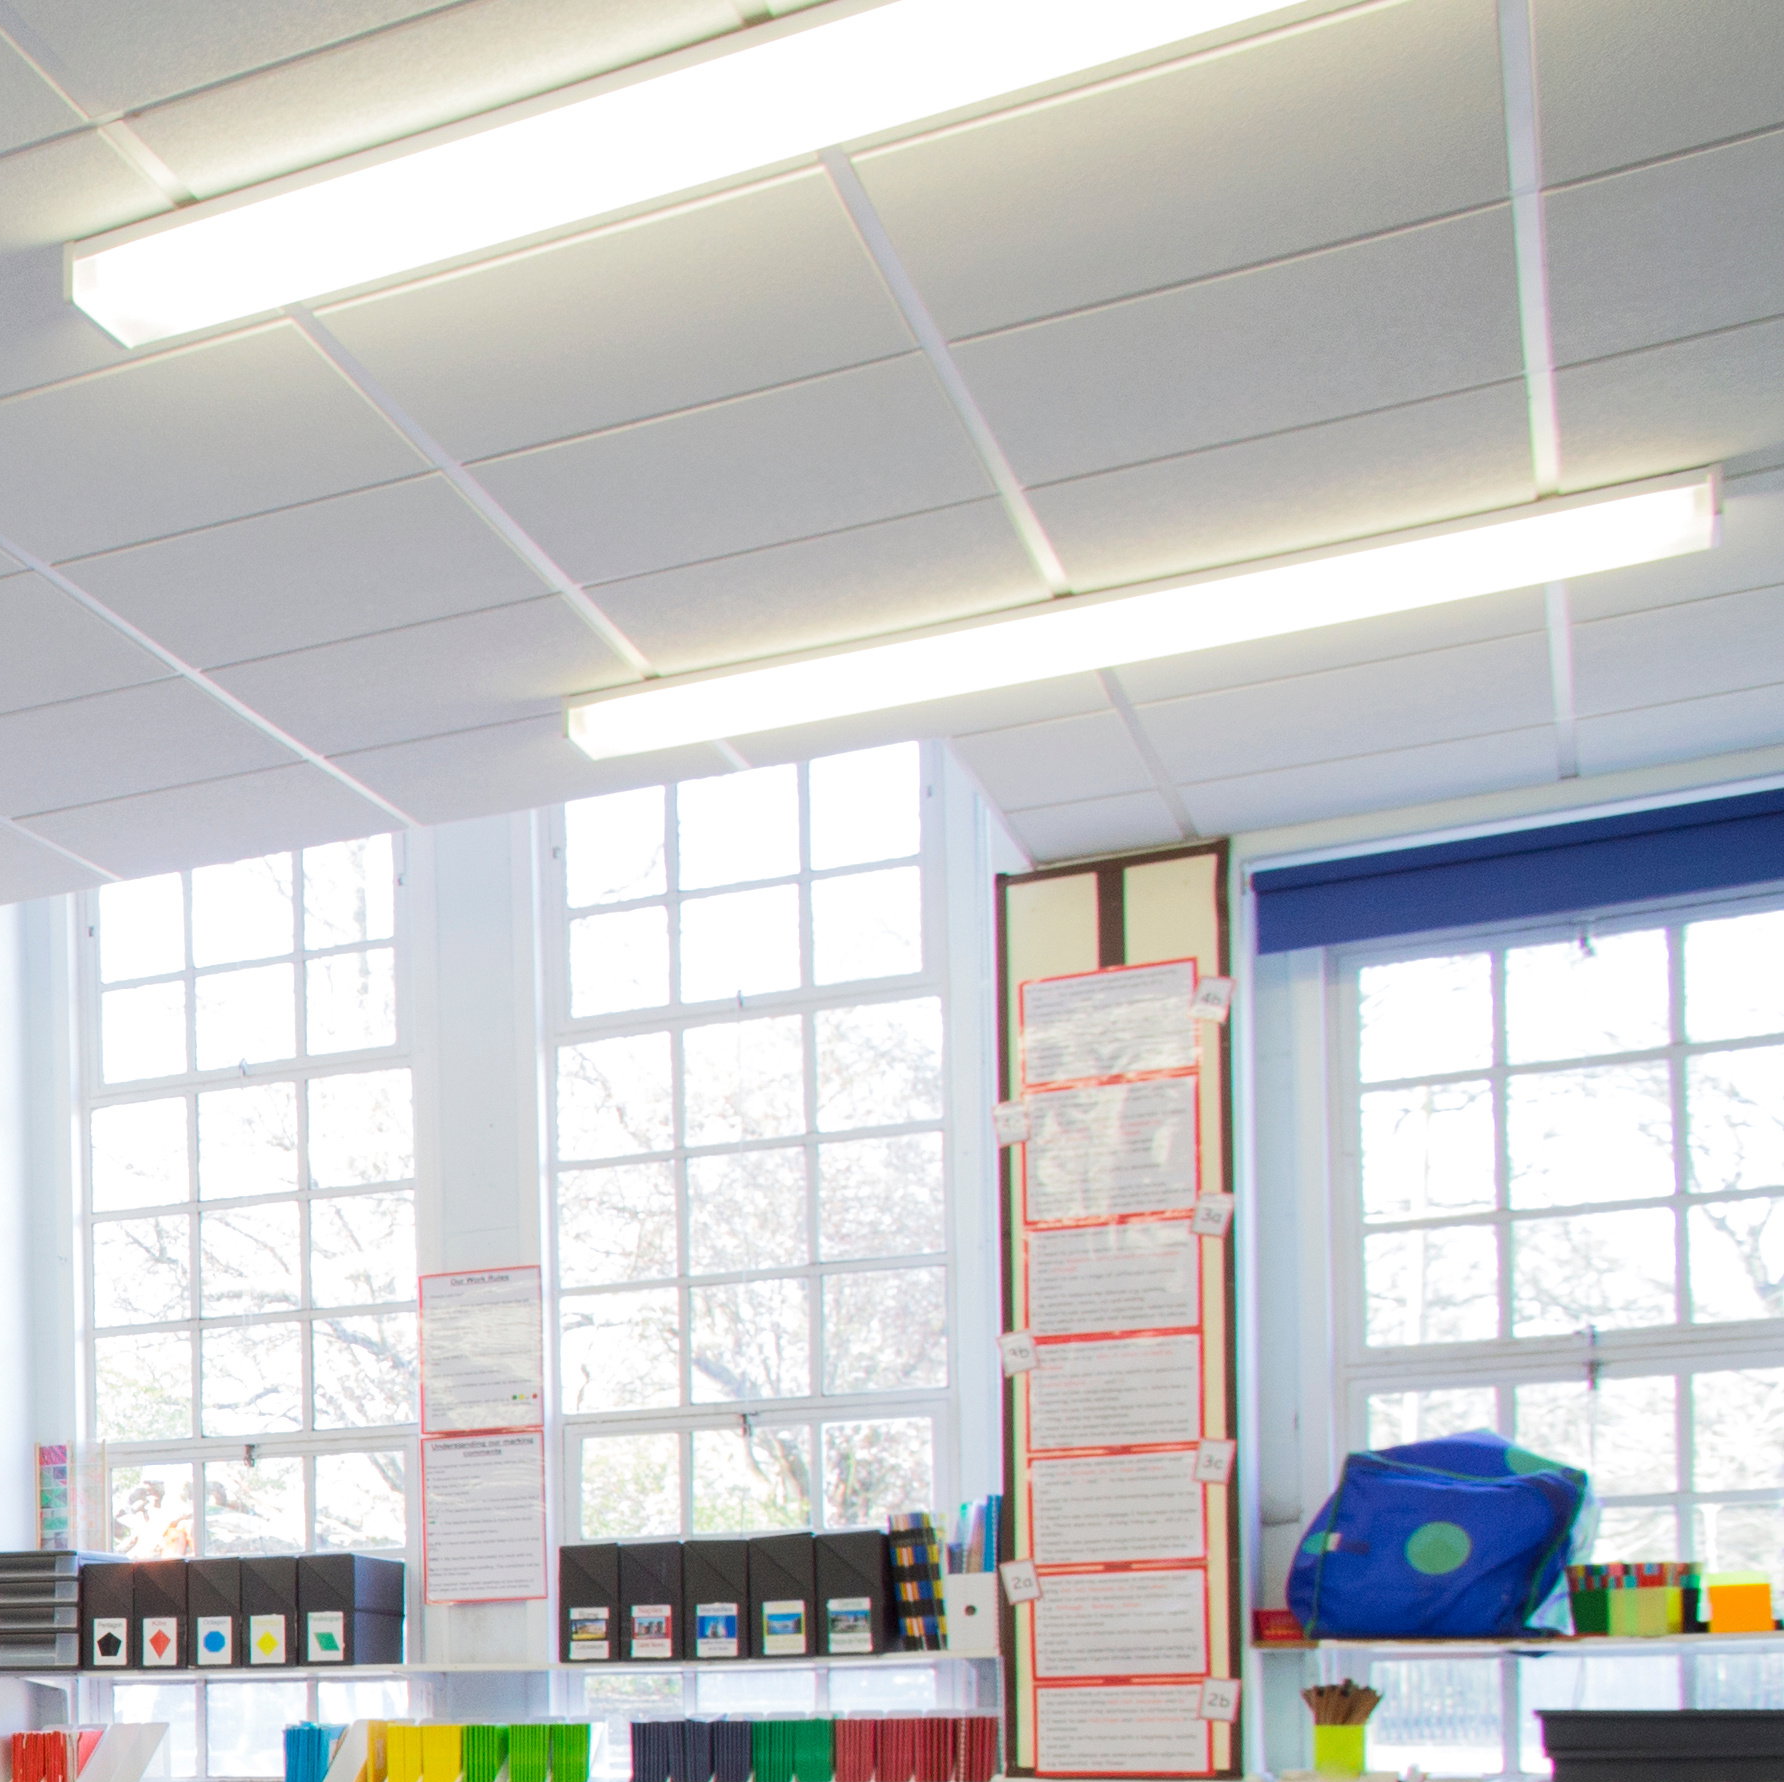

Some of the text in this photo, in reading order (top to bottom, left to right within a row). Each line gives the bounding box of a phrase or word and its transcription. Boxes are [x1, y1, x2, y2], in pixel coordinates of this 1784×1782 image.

[1203, 1454, 1224, 1470] 3c
[1012, 1576, 1034, 1590] 2a
[1208, 1692, 1229, 1708] 2b
